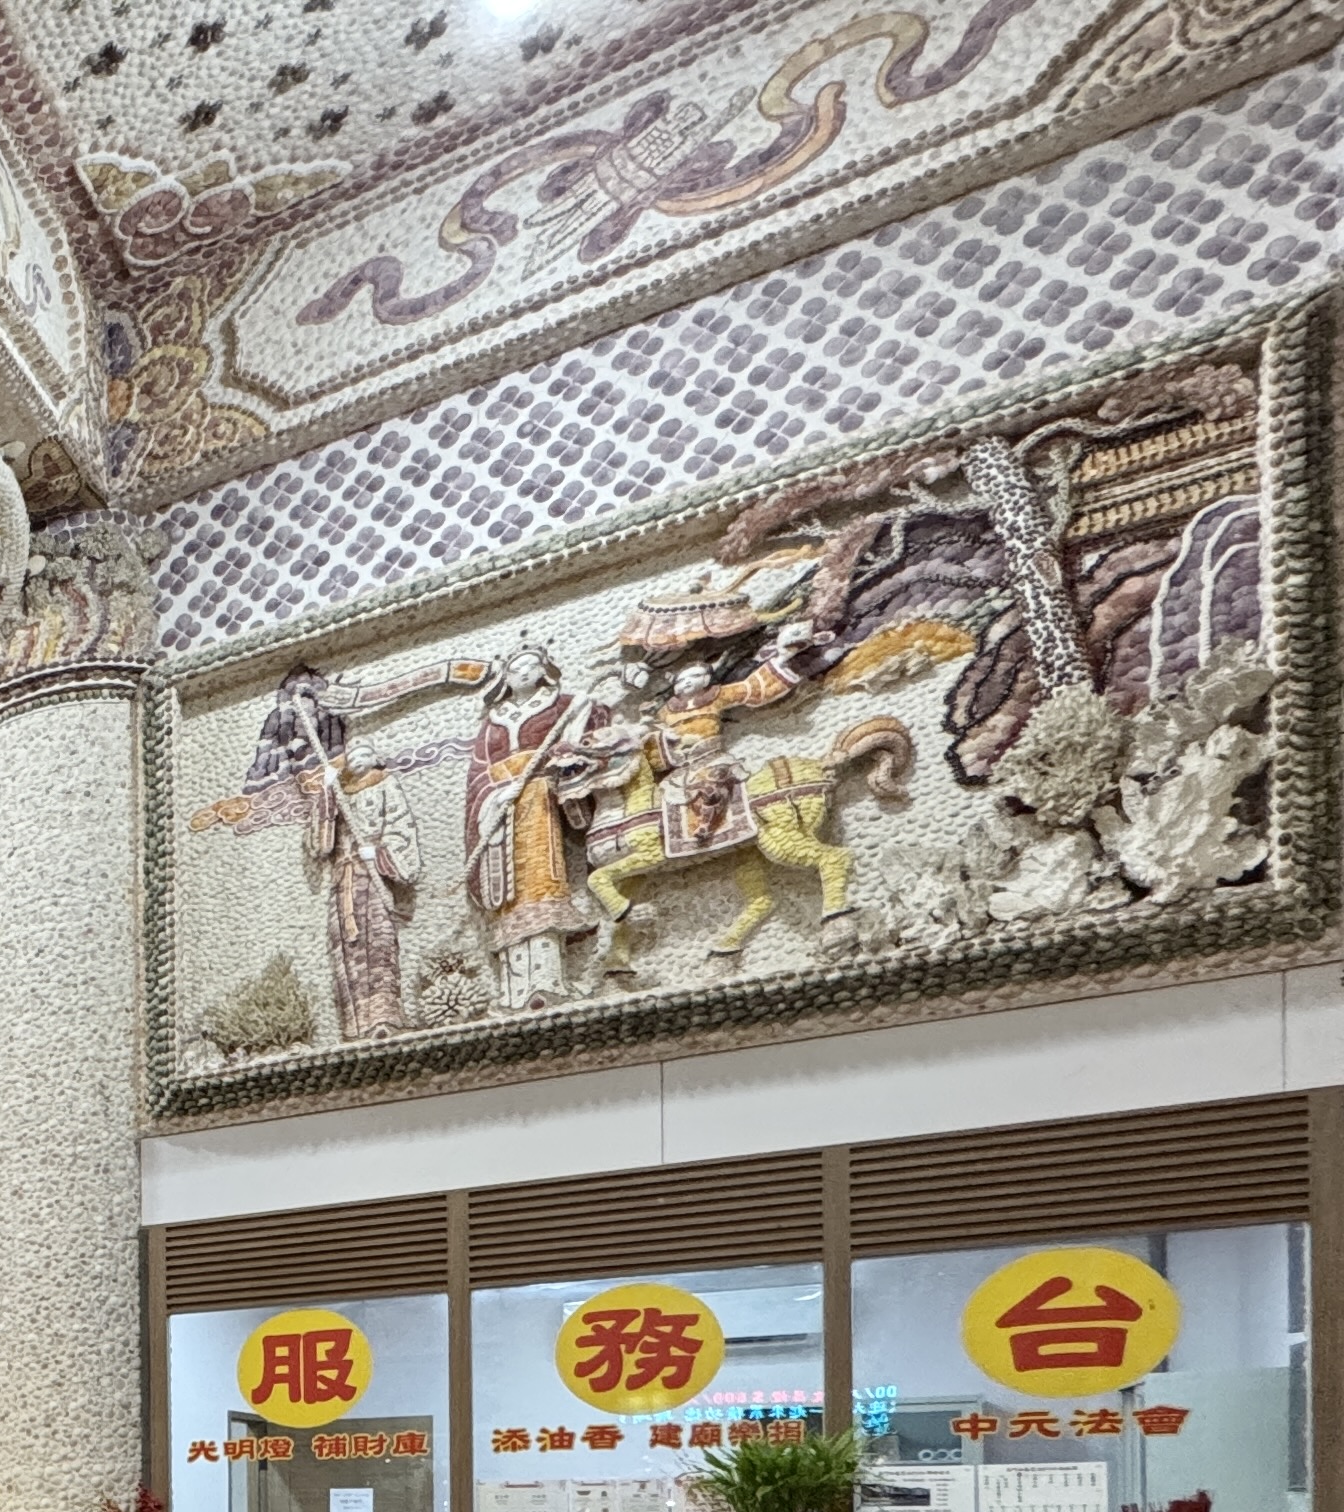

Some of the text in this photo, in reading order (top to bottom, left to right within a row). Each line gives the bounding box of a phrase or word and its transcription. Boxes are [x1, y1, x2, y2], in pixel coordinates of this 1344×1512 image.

[251, 1276, 1143, 1405] 服 務 台
[492, 1422, 624, 1453] 添油香
[649, 1417, 806, 1449] 建廟樂捐
[950, 1405, 1191, 1441] 中元法會
[187, 1430, 430, 1463] 光明燈 補財庫
